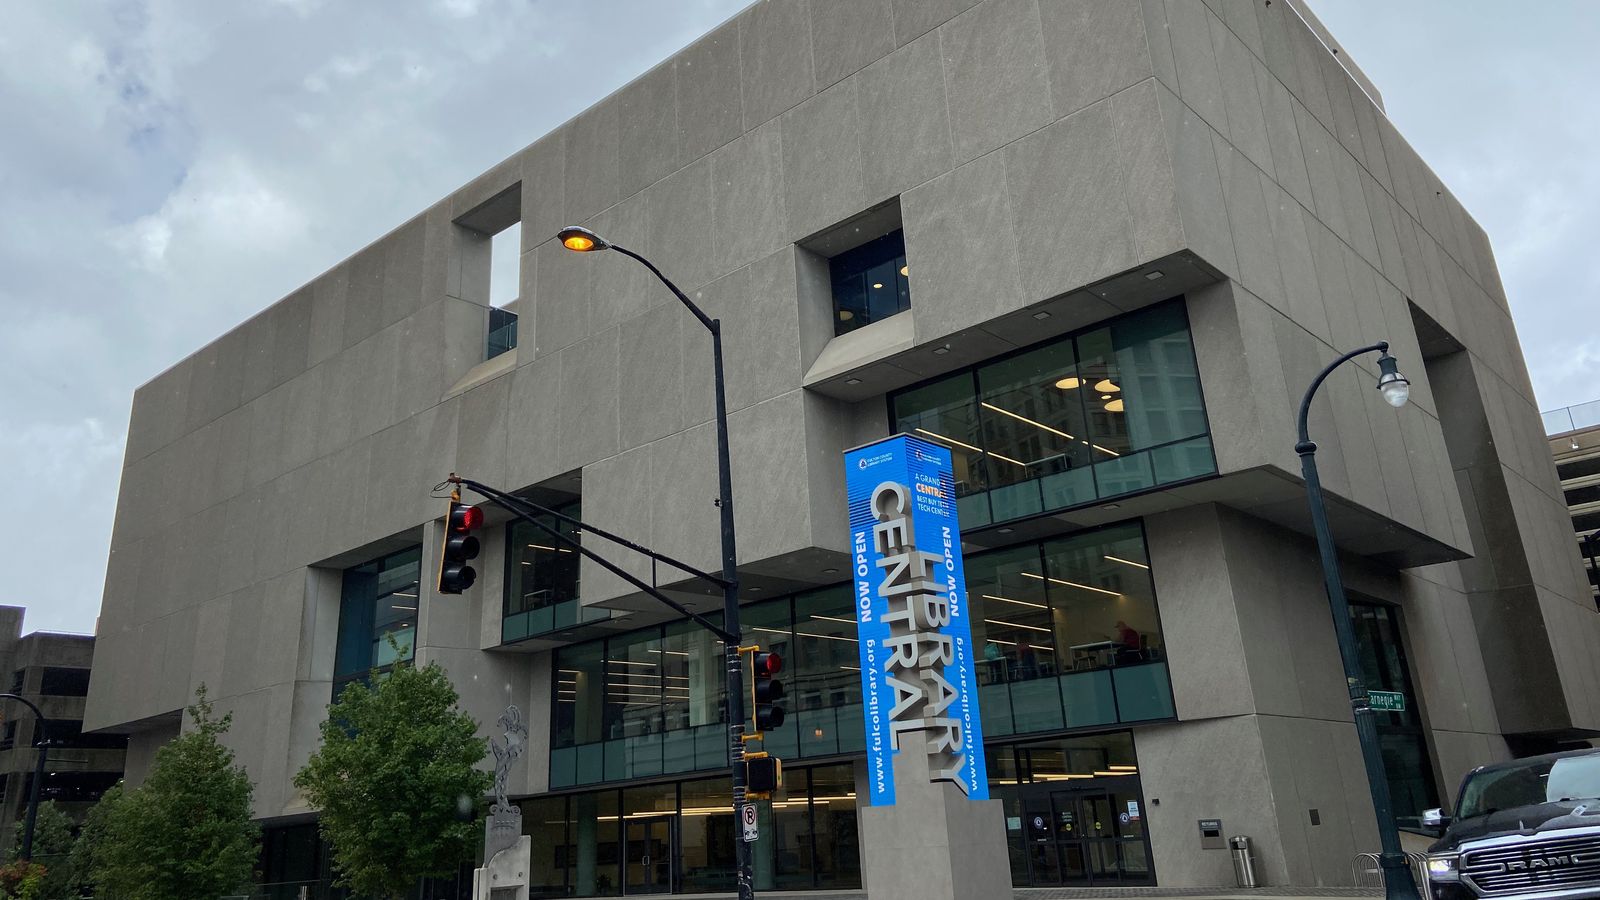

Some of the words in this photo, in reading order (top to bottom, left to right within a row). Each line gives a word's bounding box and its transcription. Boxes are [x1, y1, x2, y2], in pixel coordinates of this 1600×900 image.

[920, 474, 940, 486] GRAND
[918, 503, 931, 512] TECH
[856, 531, 870, 576] OPEN
[942, 526, 955, 572] OPEN
[859, 581, 872, 622] NOW
[870, 480, 926, 750] CENTRAL
[948, 574, 960, 617] NOW
[918, 551, 970, 797] LIBRARY
[866, 639, 885, 794] www.fulcolibrary.org
[956, 637, 978, 791] www.fulcolibrary.org
[1370, 694, 1393, 709] arnegie
[1507, 855, 1569, 871] RAM
